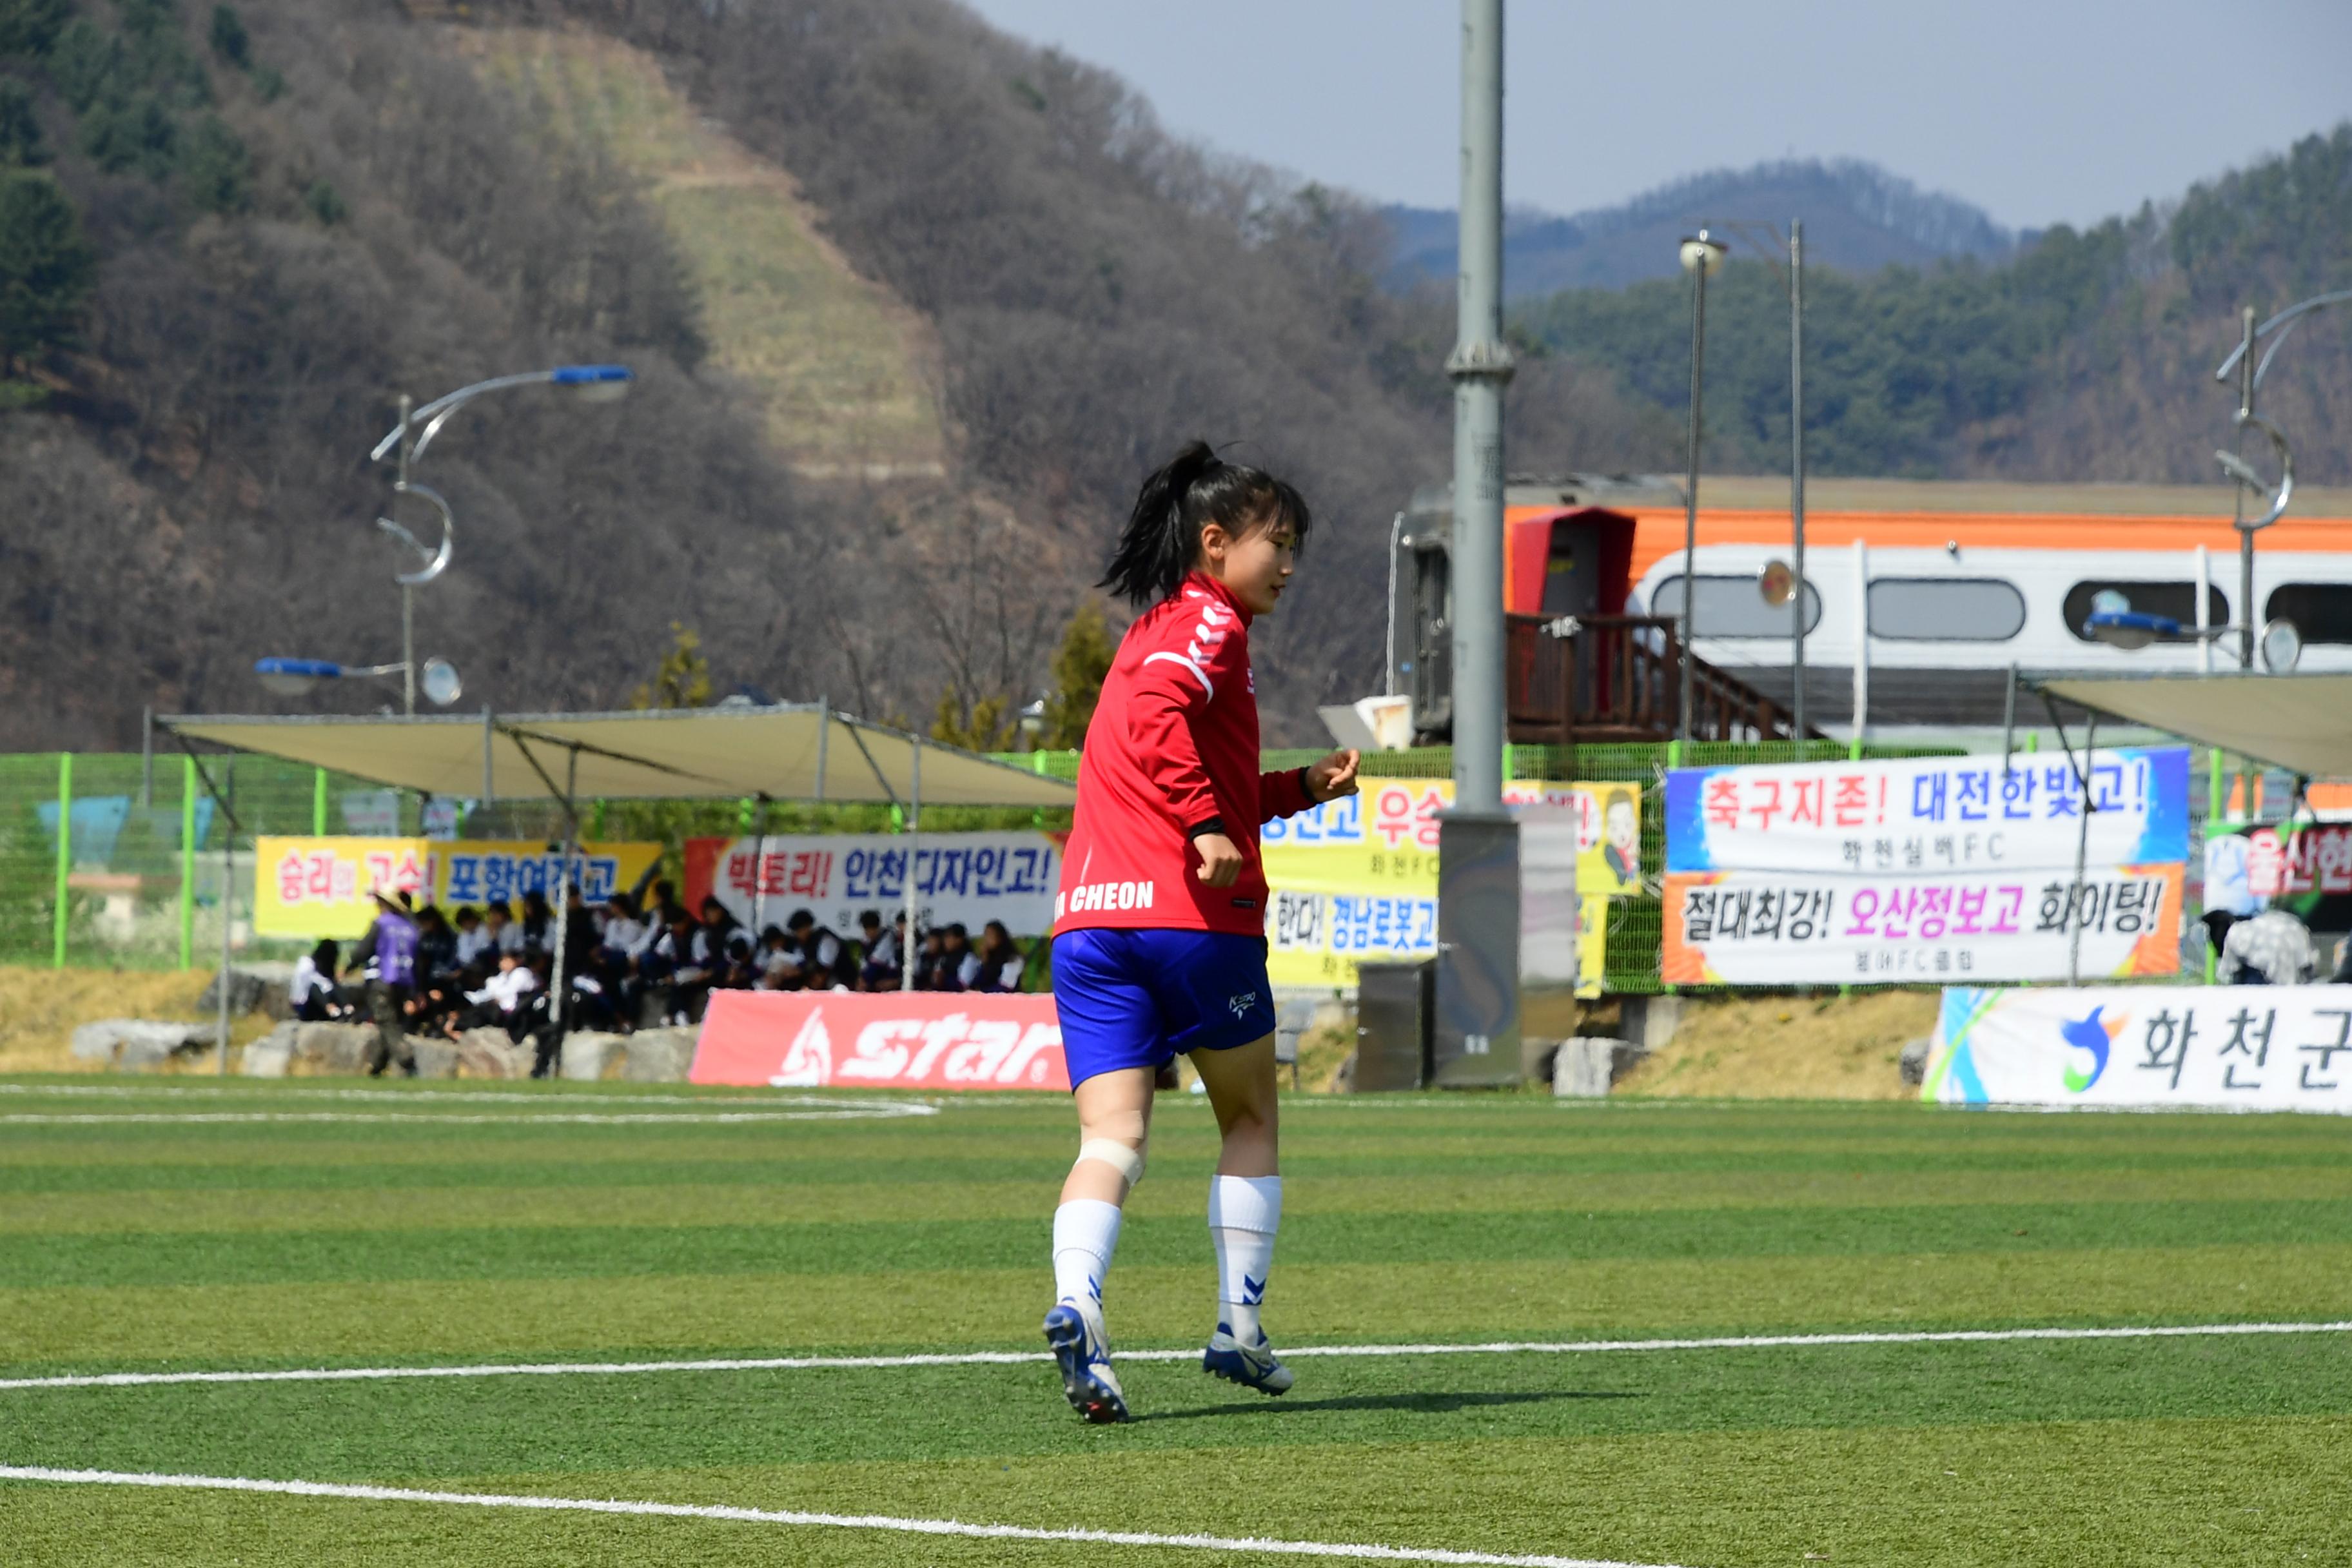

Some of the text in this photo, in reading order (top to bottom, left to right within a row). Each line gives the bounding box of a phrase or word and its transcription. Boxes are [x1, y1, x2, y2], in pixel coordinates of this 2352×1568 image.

[1707, 773, 1886, 830] 축구지존!
[728, 846, 1051, 899] 빅토리! 인천디자인고!
[1070, 881, 1153, 912] CHEON
[1333, 897, 1433, 950] 경남로봇고
[1684, 879, 2162, 941] 절대최강! 오산정보고 화이팅!
[2132, 1007, 2352, 1091] 화천군
